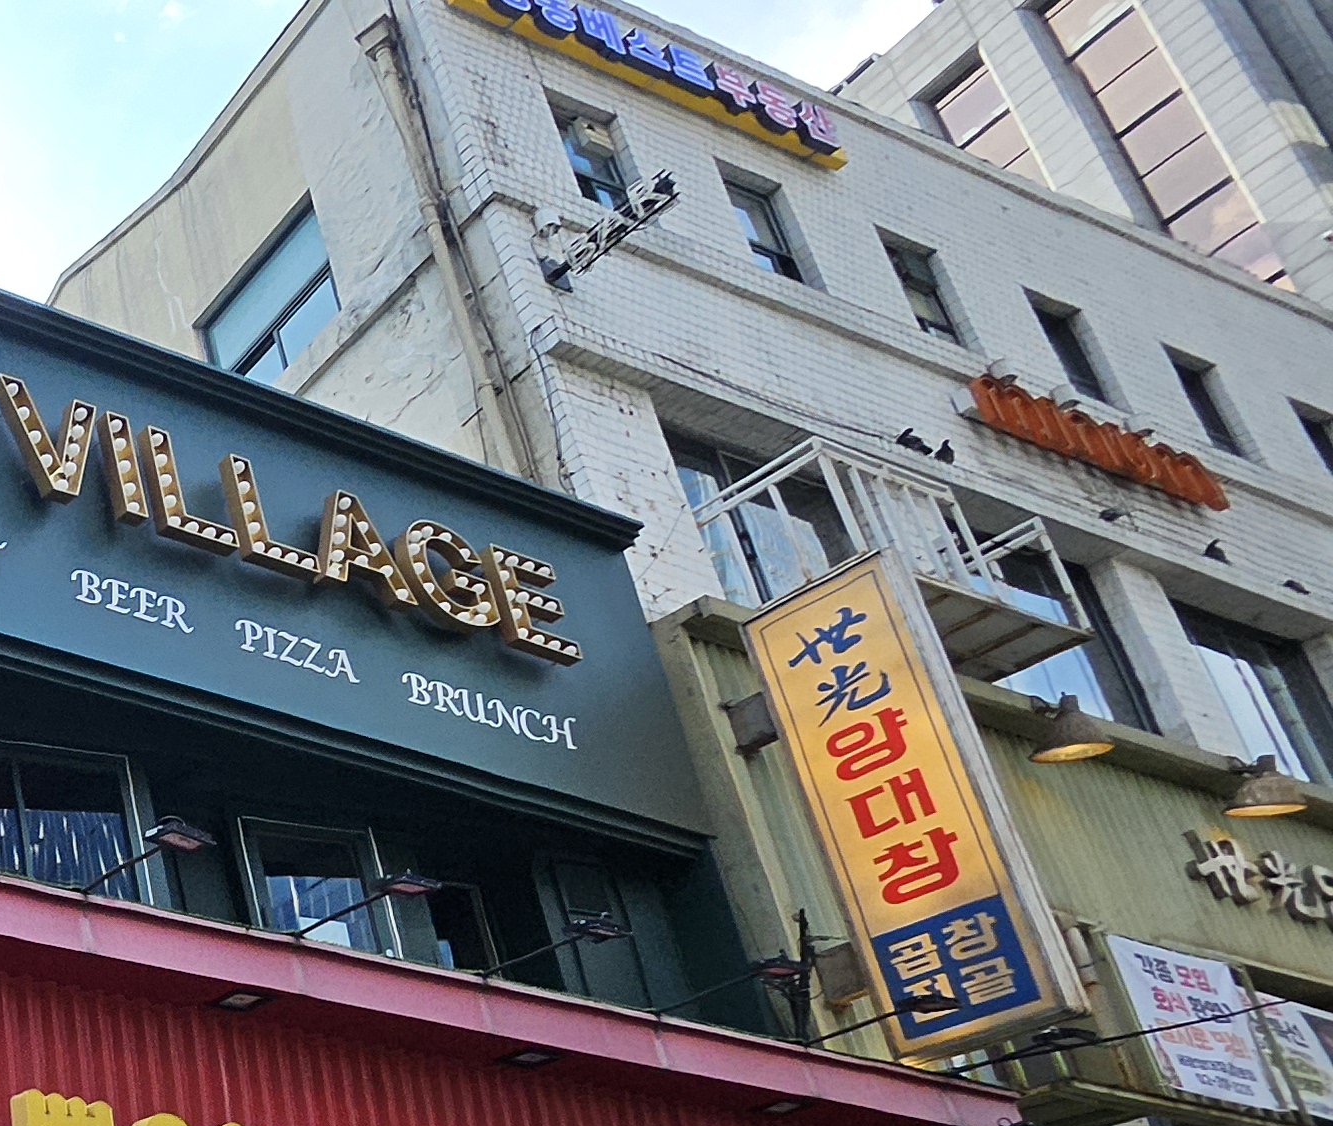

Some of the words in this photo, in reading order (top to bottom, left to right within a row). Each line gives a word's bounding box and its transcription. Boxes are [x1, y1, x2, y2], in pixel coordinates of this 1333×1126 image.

[71, 567, 194, 635] BEER
[234, 617, 360, 686] PIZZA
[401, 671, 578, 751] BRUNCH
[825, 706, 960, 906] 양대창
[887, 910, 999, 980] 곱창
